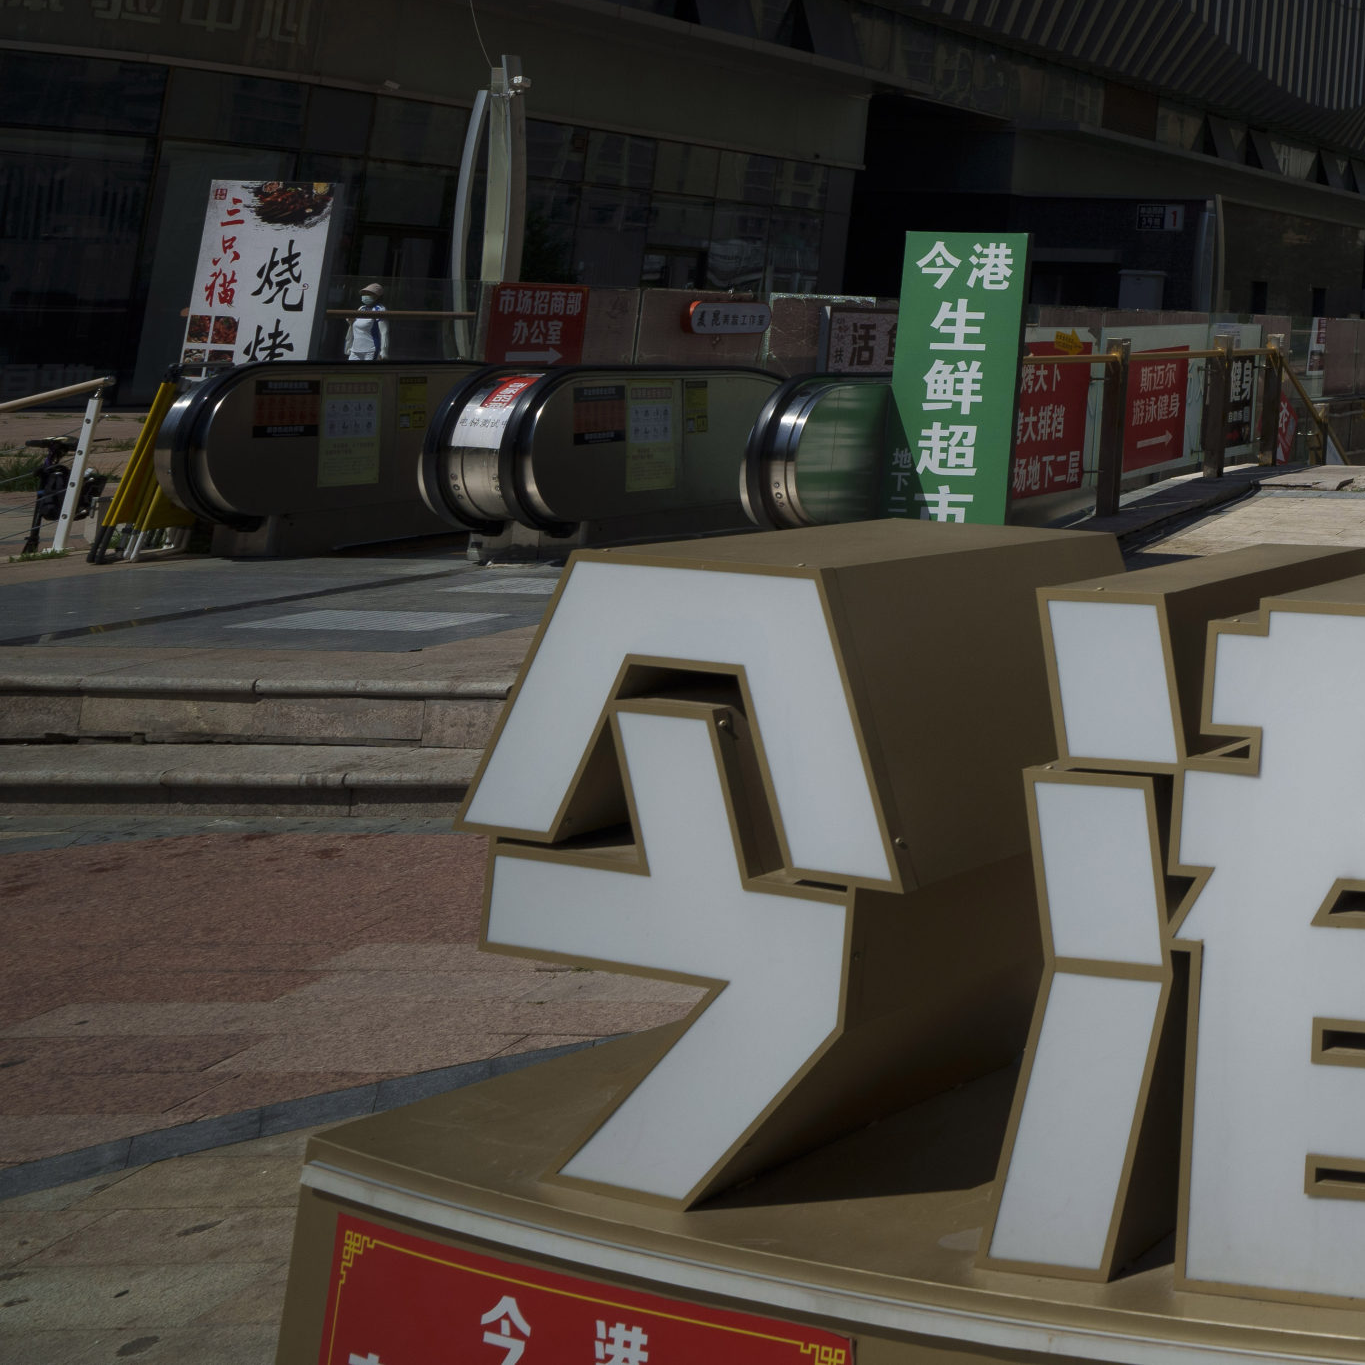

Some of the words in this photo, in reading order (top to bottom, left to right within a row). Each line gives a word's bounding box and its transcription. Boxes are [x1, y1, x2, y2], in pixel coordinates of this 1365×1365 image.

[205, 198, 244, 308] 三只猫
[915, 241, 1013, 290] 今港
[243, 240, 305, 361] 烧烤
[499, 289, 583, 316] 市场招商部
[511, 319, 564, 346] 办公室
[1139, 362, 1177, 393] 斯迈尔
[914, 298, 986, 523] 生鲜超市
[1132, 392, 1180, 427] 游泳健身
